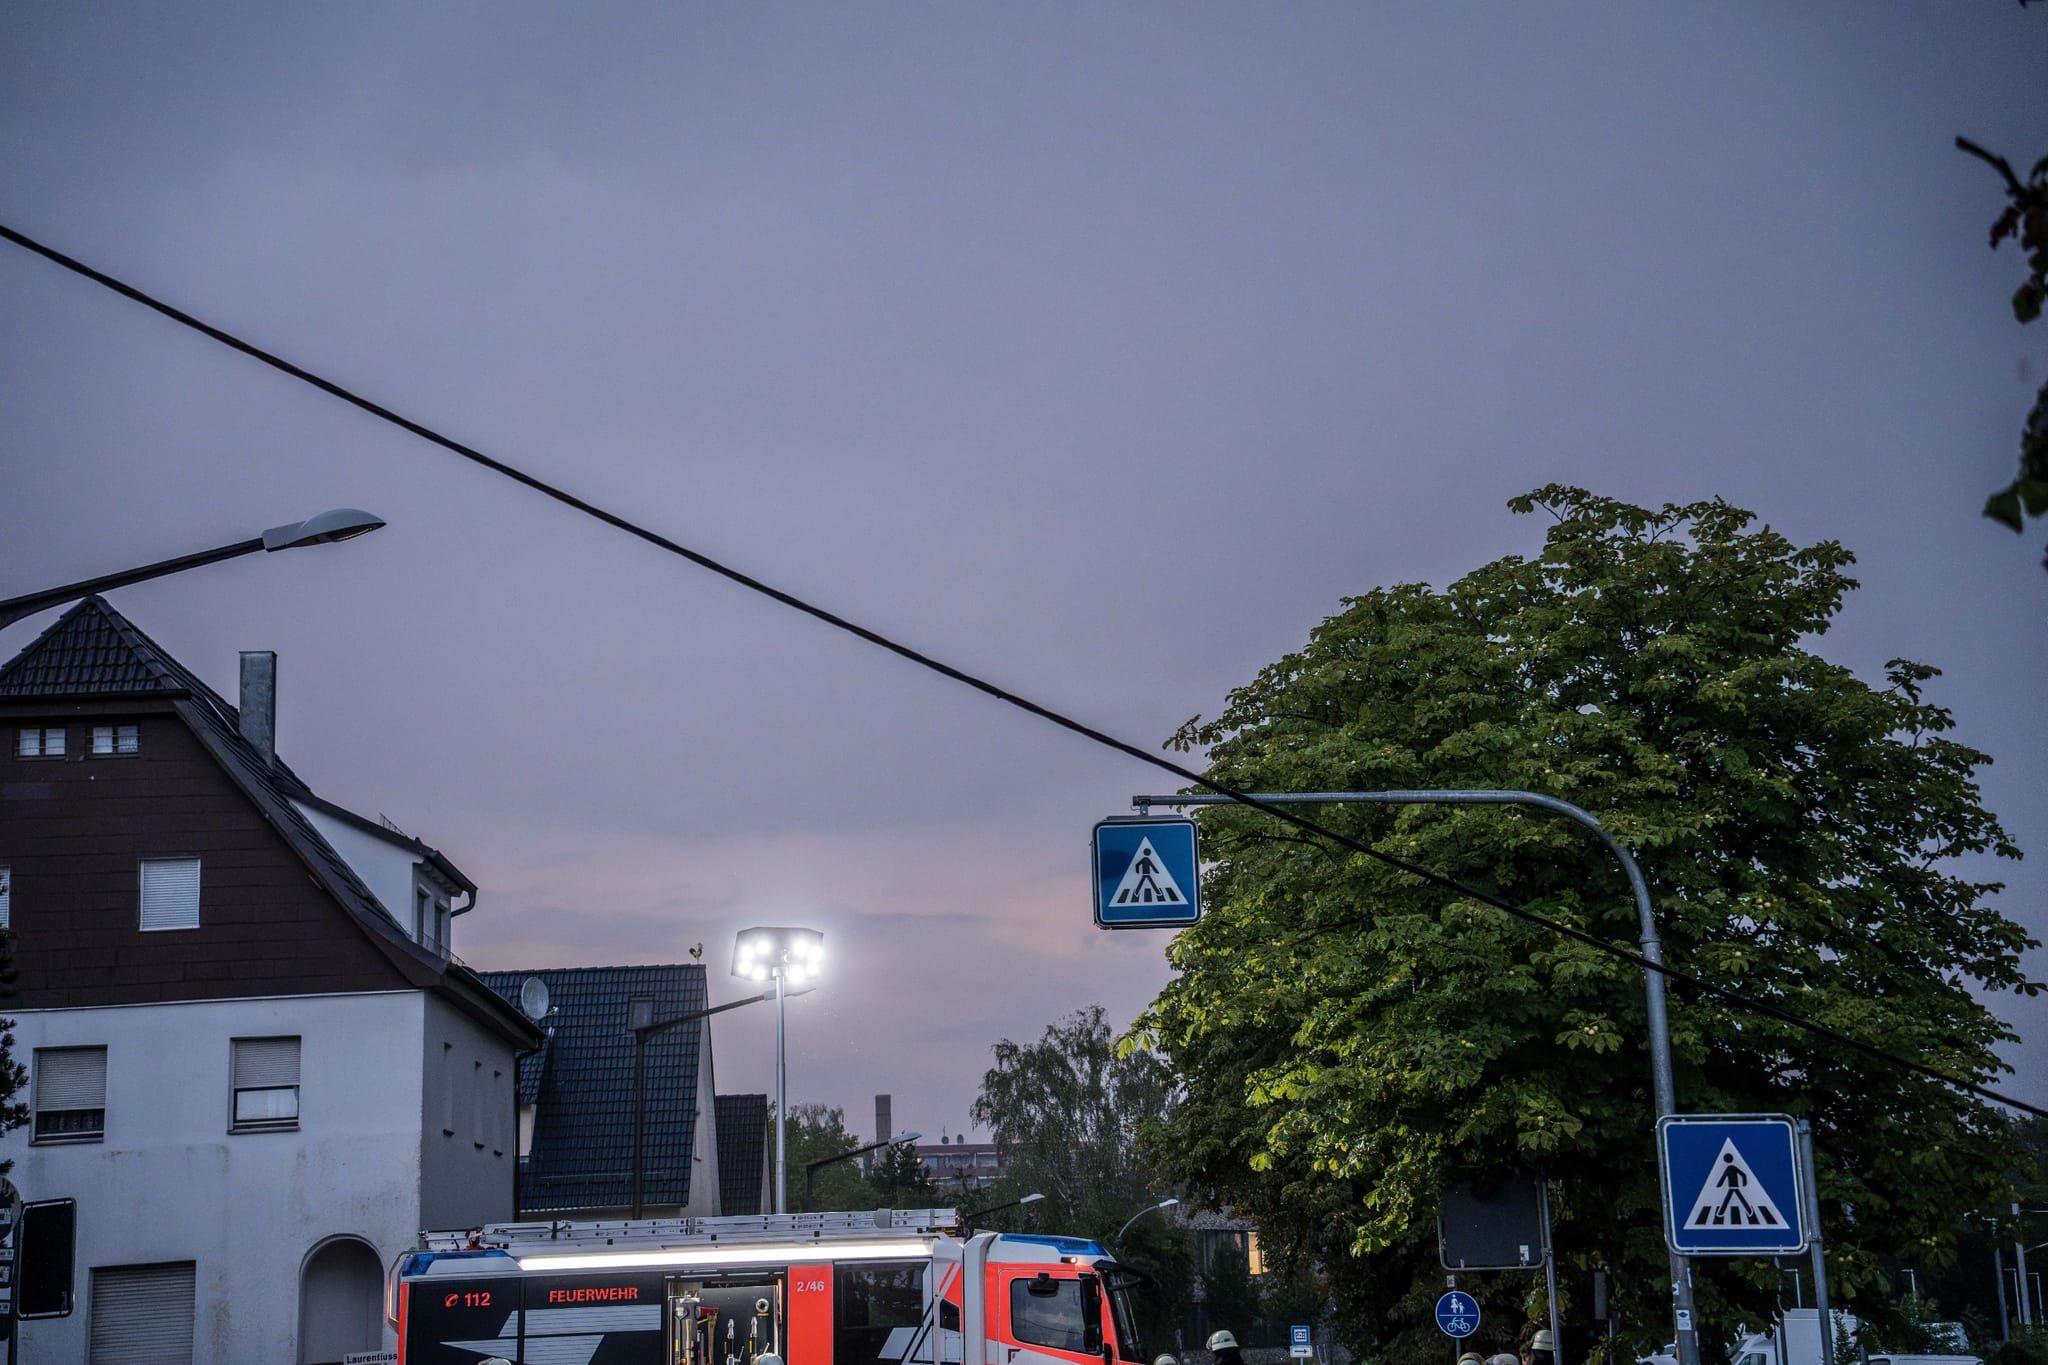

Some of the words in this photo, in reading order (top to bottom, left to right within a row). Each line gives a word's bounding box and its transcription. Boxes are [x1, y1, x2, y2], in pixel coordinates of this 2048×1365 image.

[797, 1280, 825, 1292] 2/46
[464, 1292, 490, 1307] 112
[549, 1287, 638, 1303] FEUERWEHR
